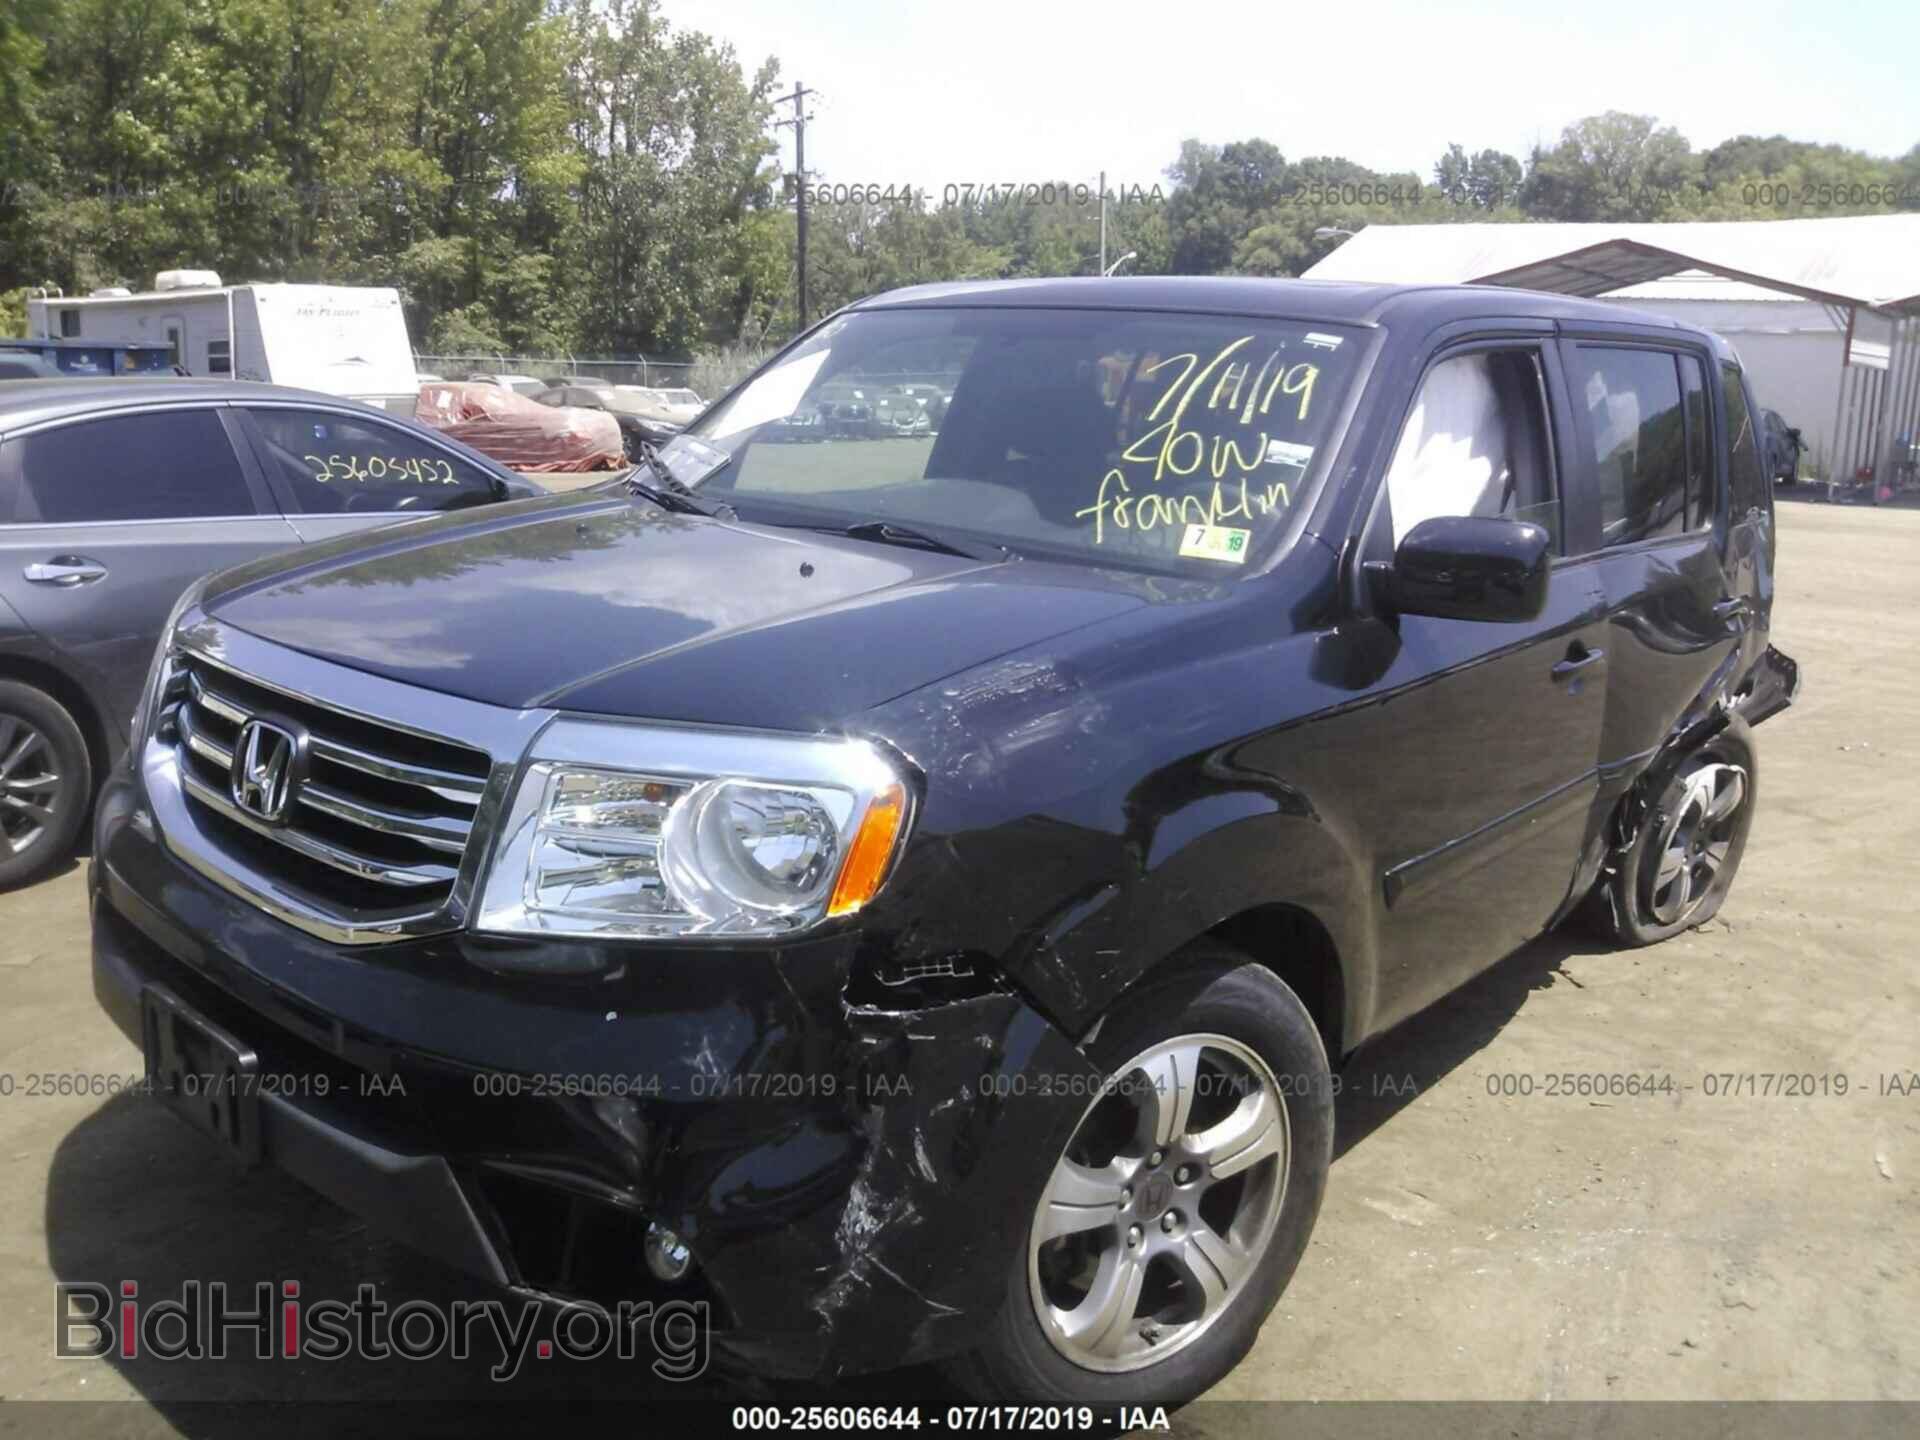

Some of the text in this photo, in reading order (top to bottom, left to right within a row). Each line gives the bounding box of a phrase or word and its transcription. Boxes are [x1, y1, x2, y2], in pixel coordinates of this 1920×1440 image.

[304, 454, 460, 485] 25605452
[1194, 528, 1206, 545] 7
[1228, 535, 1244, 552] 19
